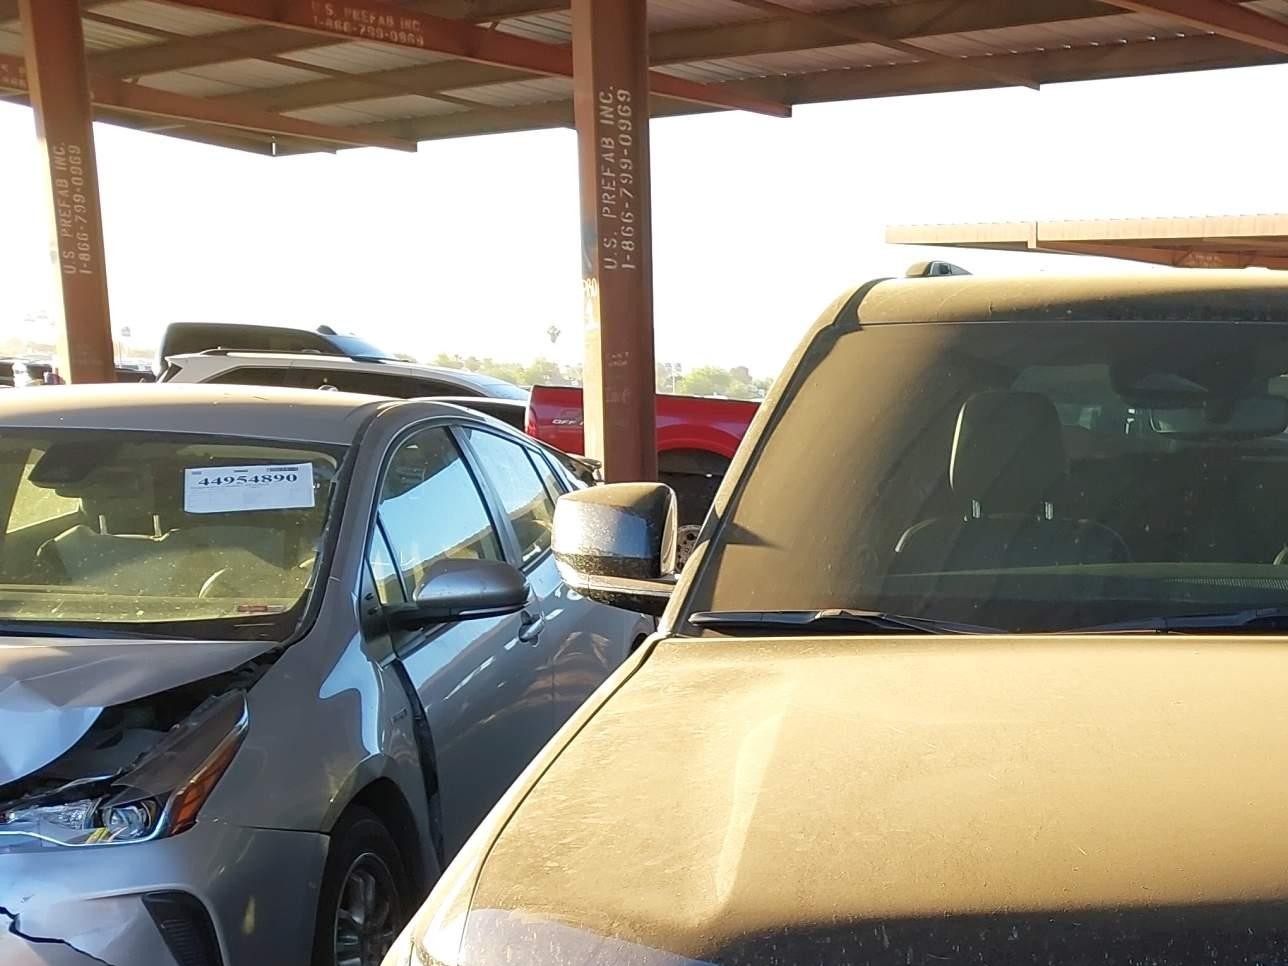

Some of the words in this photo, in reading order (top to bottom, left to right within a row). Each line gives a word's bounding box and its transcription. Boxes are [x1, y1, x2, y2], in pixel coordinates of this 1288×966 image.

[599, 85, 614, 125] INC.
[600, 137, 617, 218] PREFAB
[617, 89, 636, 270] 1-866-799-0969
[56, 178, 74, 238] PREFAB
[68, 144, 93, 275] 1-866-799-0969
[602, 230, 618, 270] U.S.
[198, 473, 298, 486] 44954890
